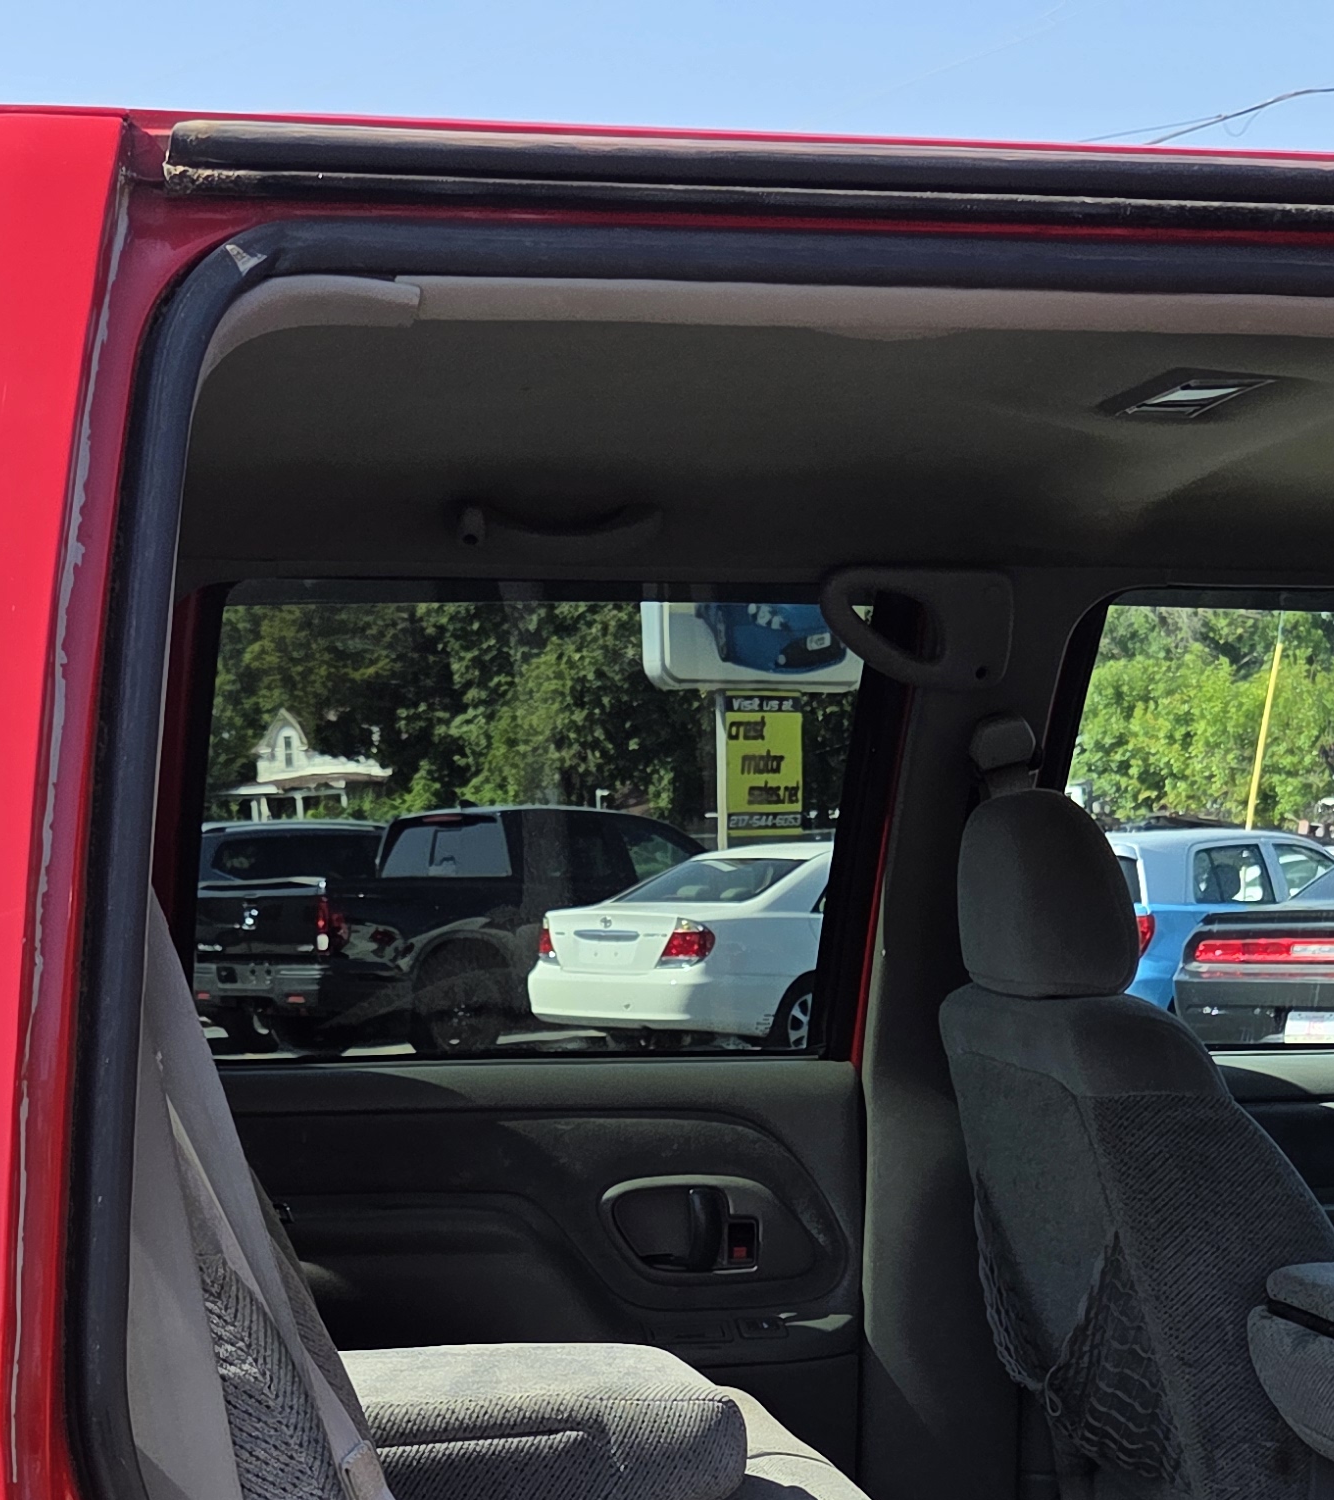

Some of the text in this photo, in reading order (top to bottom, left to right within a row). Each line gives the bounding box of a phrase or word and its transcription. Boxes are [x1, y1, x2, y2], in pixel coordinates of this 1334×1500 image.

[732, 697, 794, 711] Visit us at
[741, 749, 785, 775] motor
